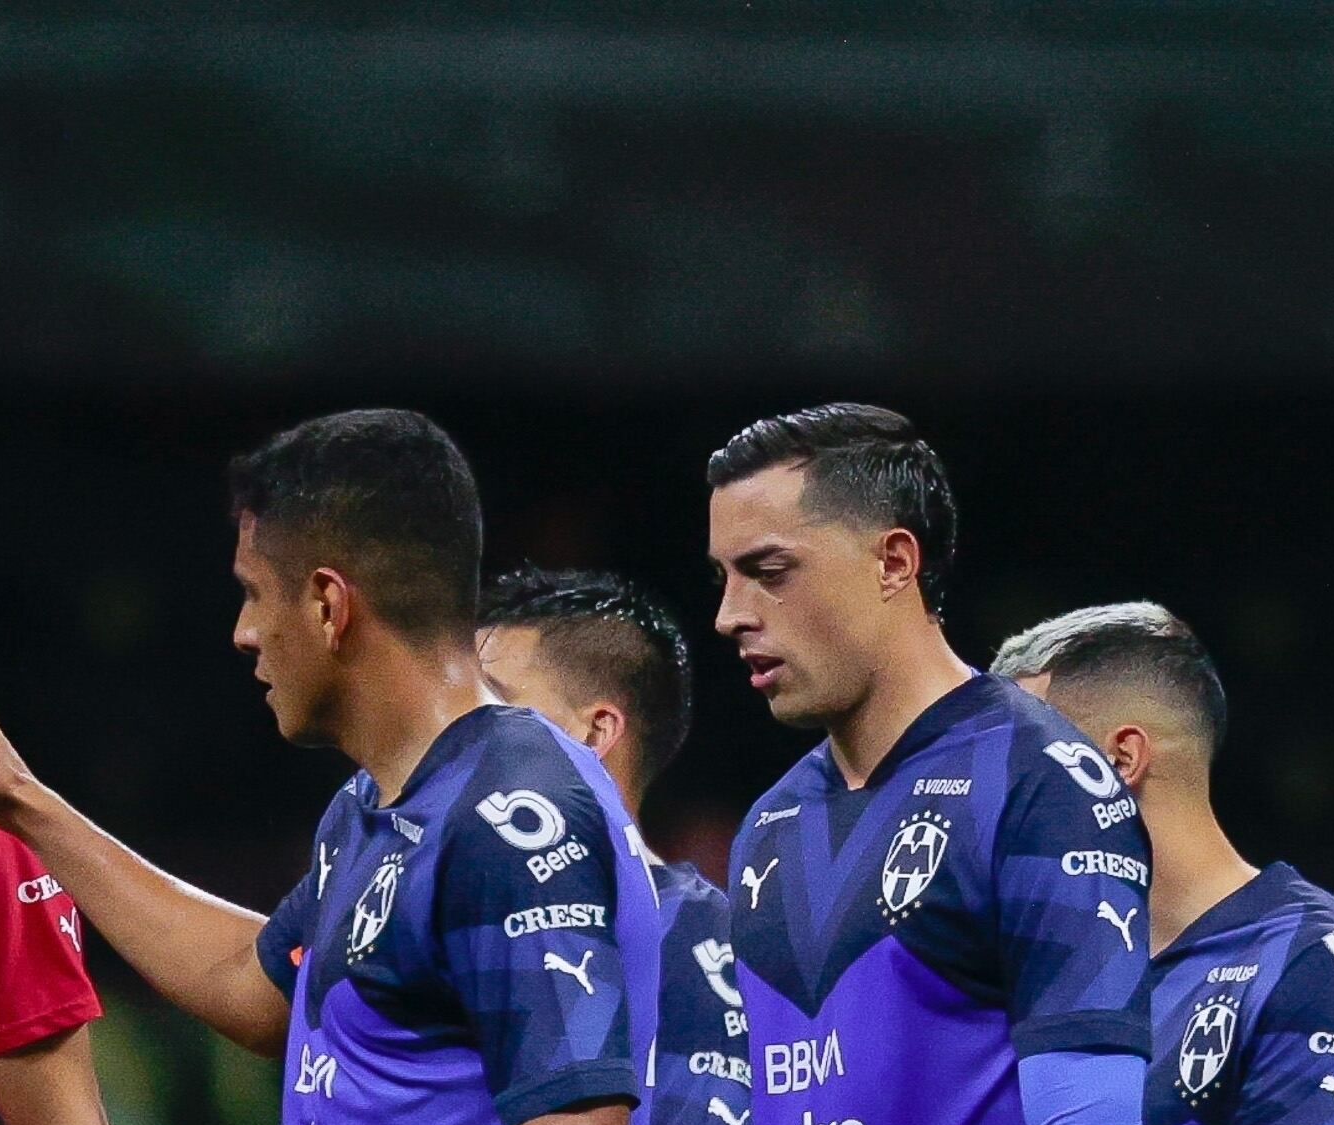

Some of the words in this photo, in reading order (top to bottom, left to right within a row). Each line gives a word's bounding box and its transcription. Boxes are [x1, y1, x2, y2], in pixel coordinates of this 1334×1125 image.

[1061, 850, 1149, 887] CREST
[504, 903, 607, 938] CREST
[765, 1028, 845, 1095] BBVA
